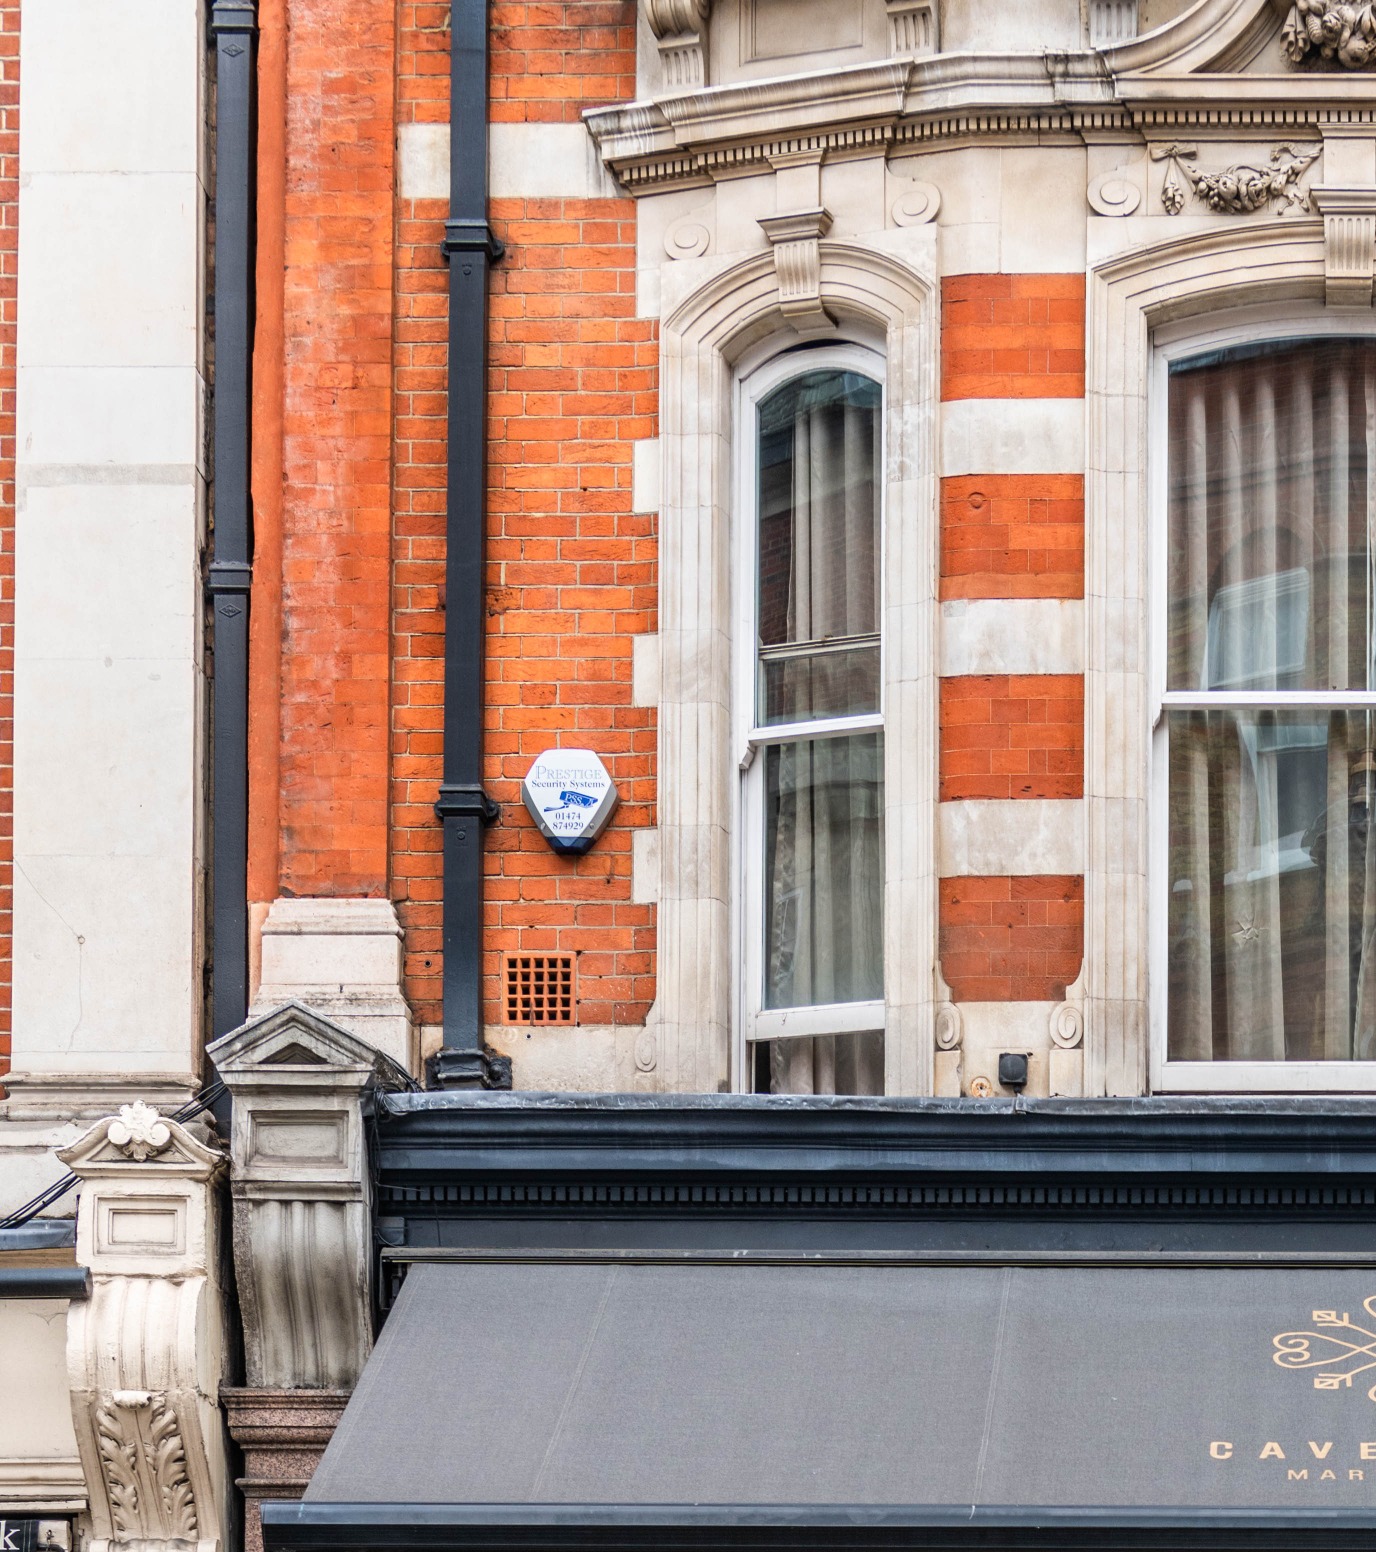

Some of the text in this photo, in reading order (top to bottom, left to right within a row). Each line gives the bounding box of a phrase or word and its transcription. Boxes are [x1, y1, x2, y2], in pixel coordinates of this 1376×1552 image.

[535, 765, 602, 780] PRESTIGE
[532, 780, 605, 790] Security Systems
[565, 793, 583, 804] PSS
[555, 812, 581, 820] 01474
[553, 822, 584, 830] 874929
